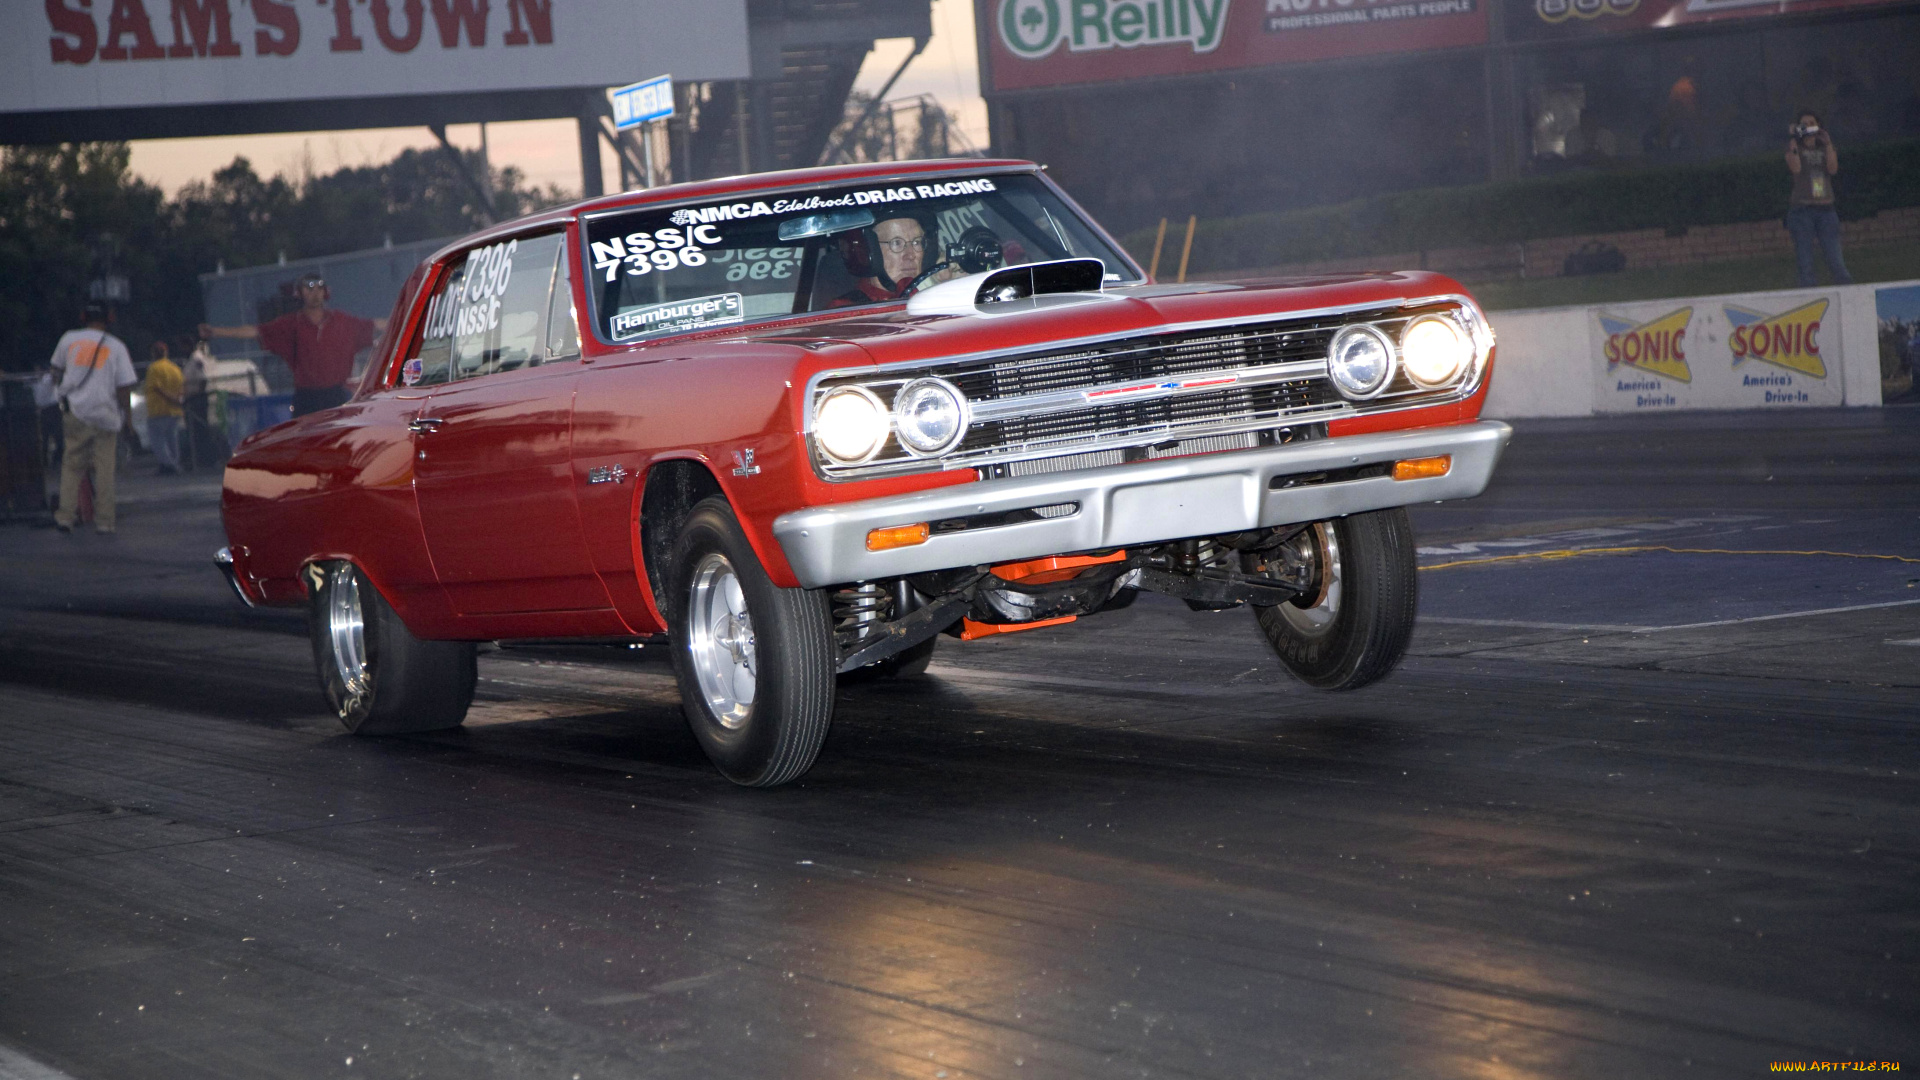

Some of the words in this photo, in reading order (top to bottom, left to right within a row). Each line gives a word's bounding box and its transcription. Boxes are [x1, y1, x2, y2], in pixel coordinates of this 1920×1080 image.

[44, 0, 301, 65] SAMS
[315, 0, 554, 53] TOWN
[1269, 9, 1369, 30] PROFESSIONAL
[1372, 4, 1418, 20] PARTS
[1418, 0, 1471, 16] PEOPLE
[689, 202, 774, 225] NMCA
[772, 194, 856, 214] Edelbrock
[853, 187, 917, 205] DRAG
[916, 178, 997, 199] RACING
[590, 224, 723, 263] NSS/C
[461, 239, 518, 303] 7396
[594, 246, 707, 282] 7396
[616, 295, 738, 331] Hamburger's
[658, 321, 674, 329] OIL
[676, 316, 705, 326] PANS
[1608, 328, 1686, 363] SONIC
[1733, 321, 1820, 357] SONIC
[1617, 377, 1661, 392] America's
[1743, 370, 1792, 387] America's
[1637, 394, 1676, 407] Drive-In
[1765, 389, 1809, 404] Drive-In
